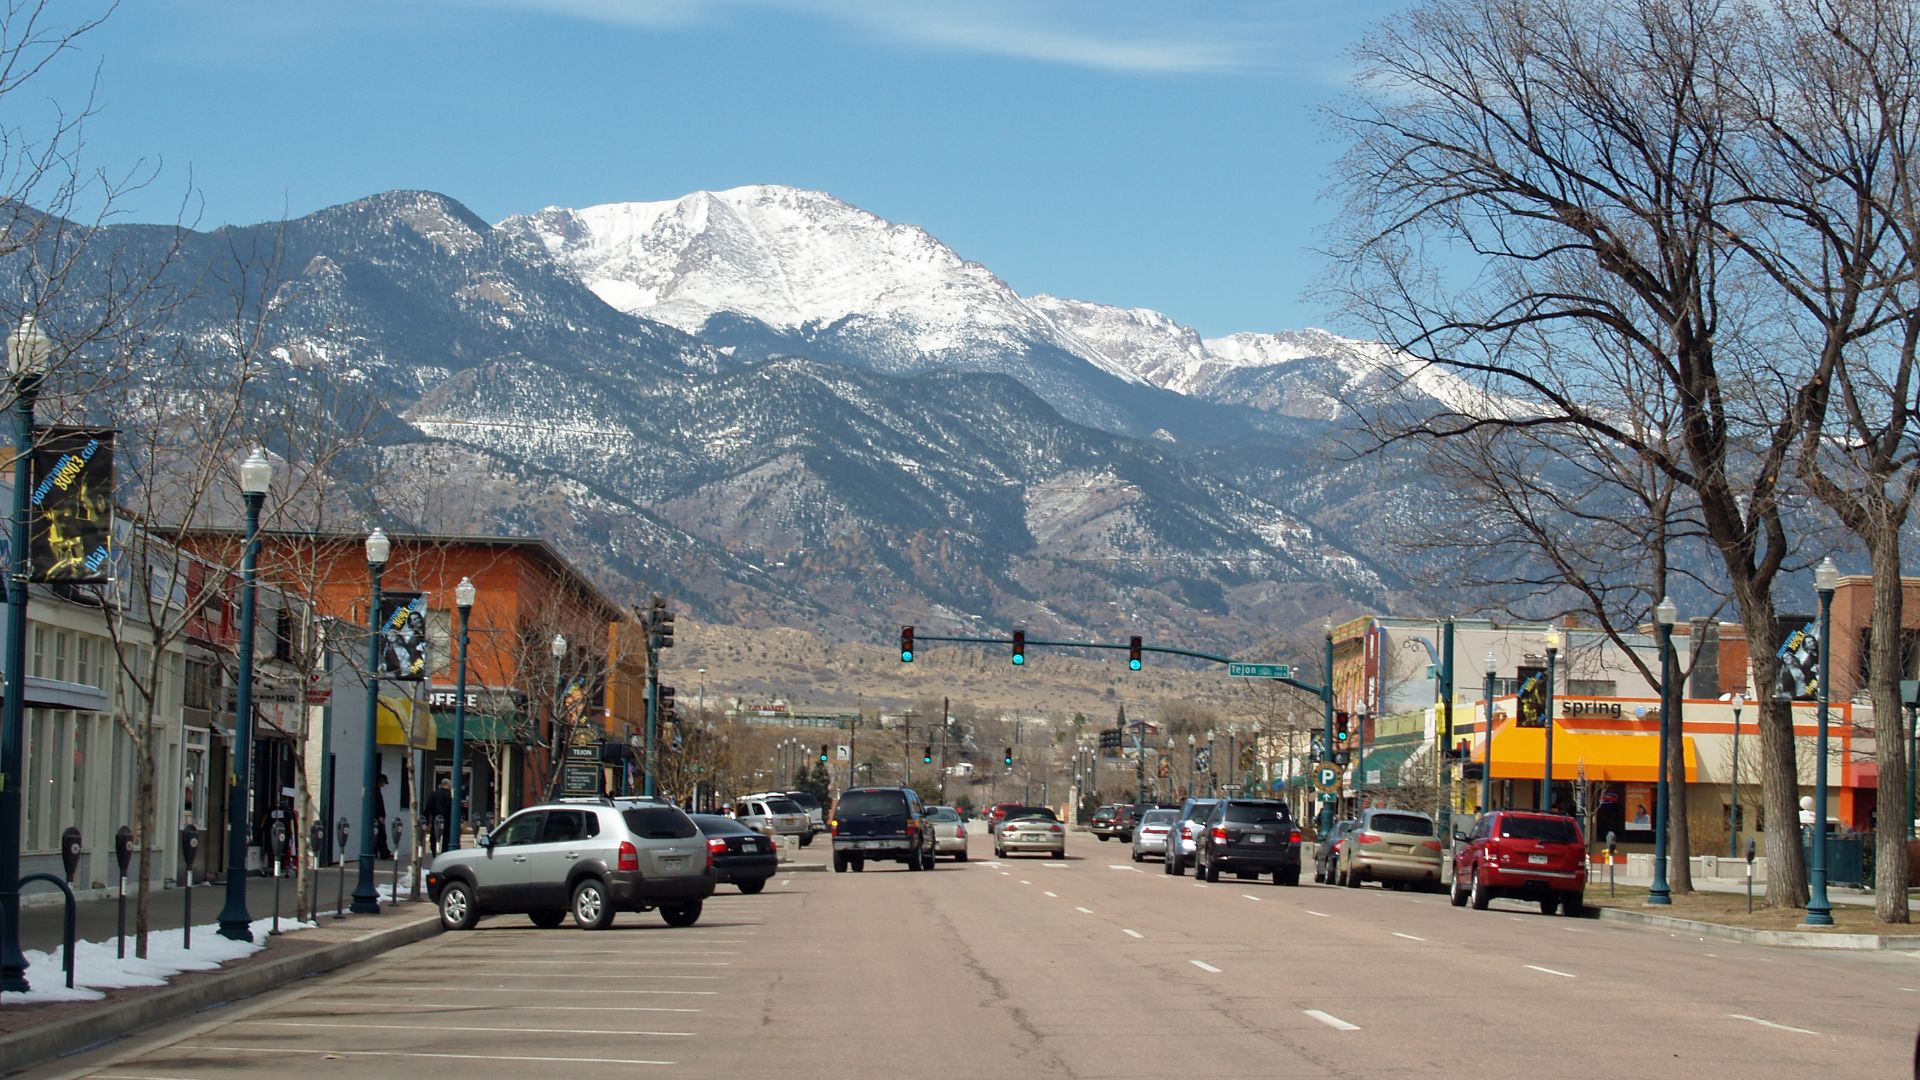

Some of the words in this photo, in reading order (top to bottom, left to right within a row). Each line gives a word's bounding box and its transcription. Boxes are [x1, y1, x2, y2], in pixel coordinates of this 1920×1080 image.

[33, 453, 72, 505] DOWNTOWN
[84, 545, 108, 572] play
[1231, 665, 1256, 676] Tejon
[1562, 700, 1621, 718] spring
[1322, 769, 1334, 785] P
